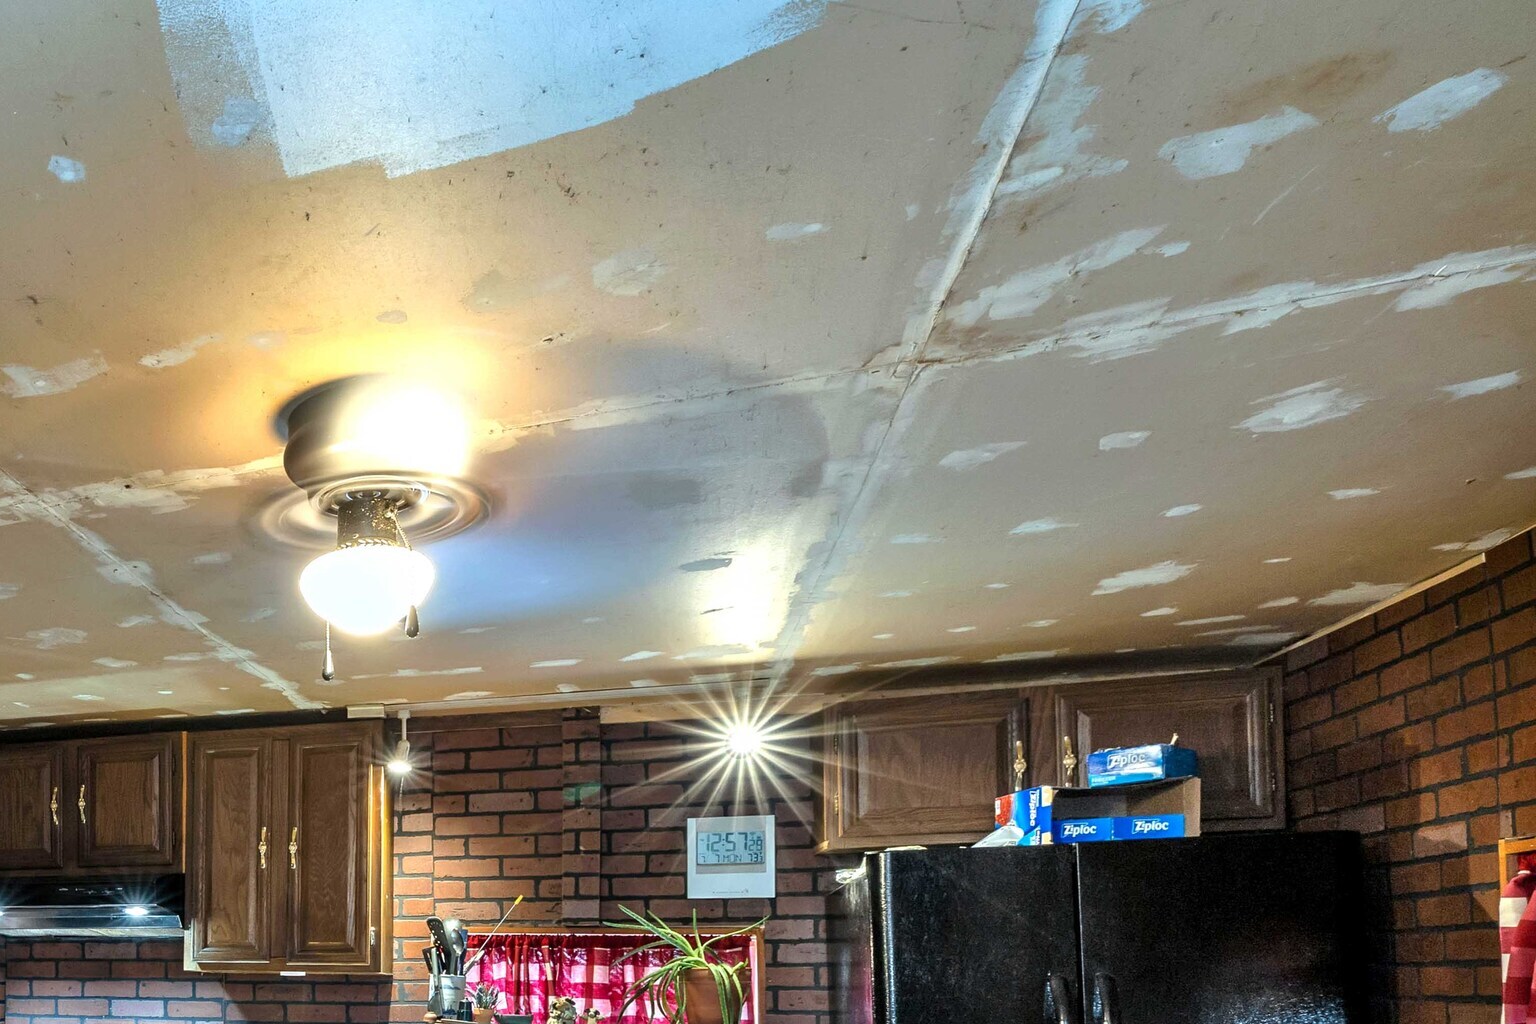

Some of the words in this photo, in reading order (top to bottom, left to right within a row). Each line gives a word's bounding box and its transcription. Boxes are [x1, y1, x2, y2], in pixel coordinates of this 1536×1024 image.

[1109, 753, 1146, 768] Ziploc
[1029, 790, 1037, 827] Ziploc
[1063, 823, 1097, 838] Ziploc
[1134, 820, 1170, 832] Ziploc
[706, 832, 748, 852] 12:57
[722, 854, 743, 863] MON
